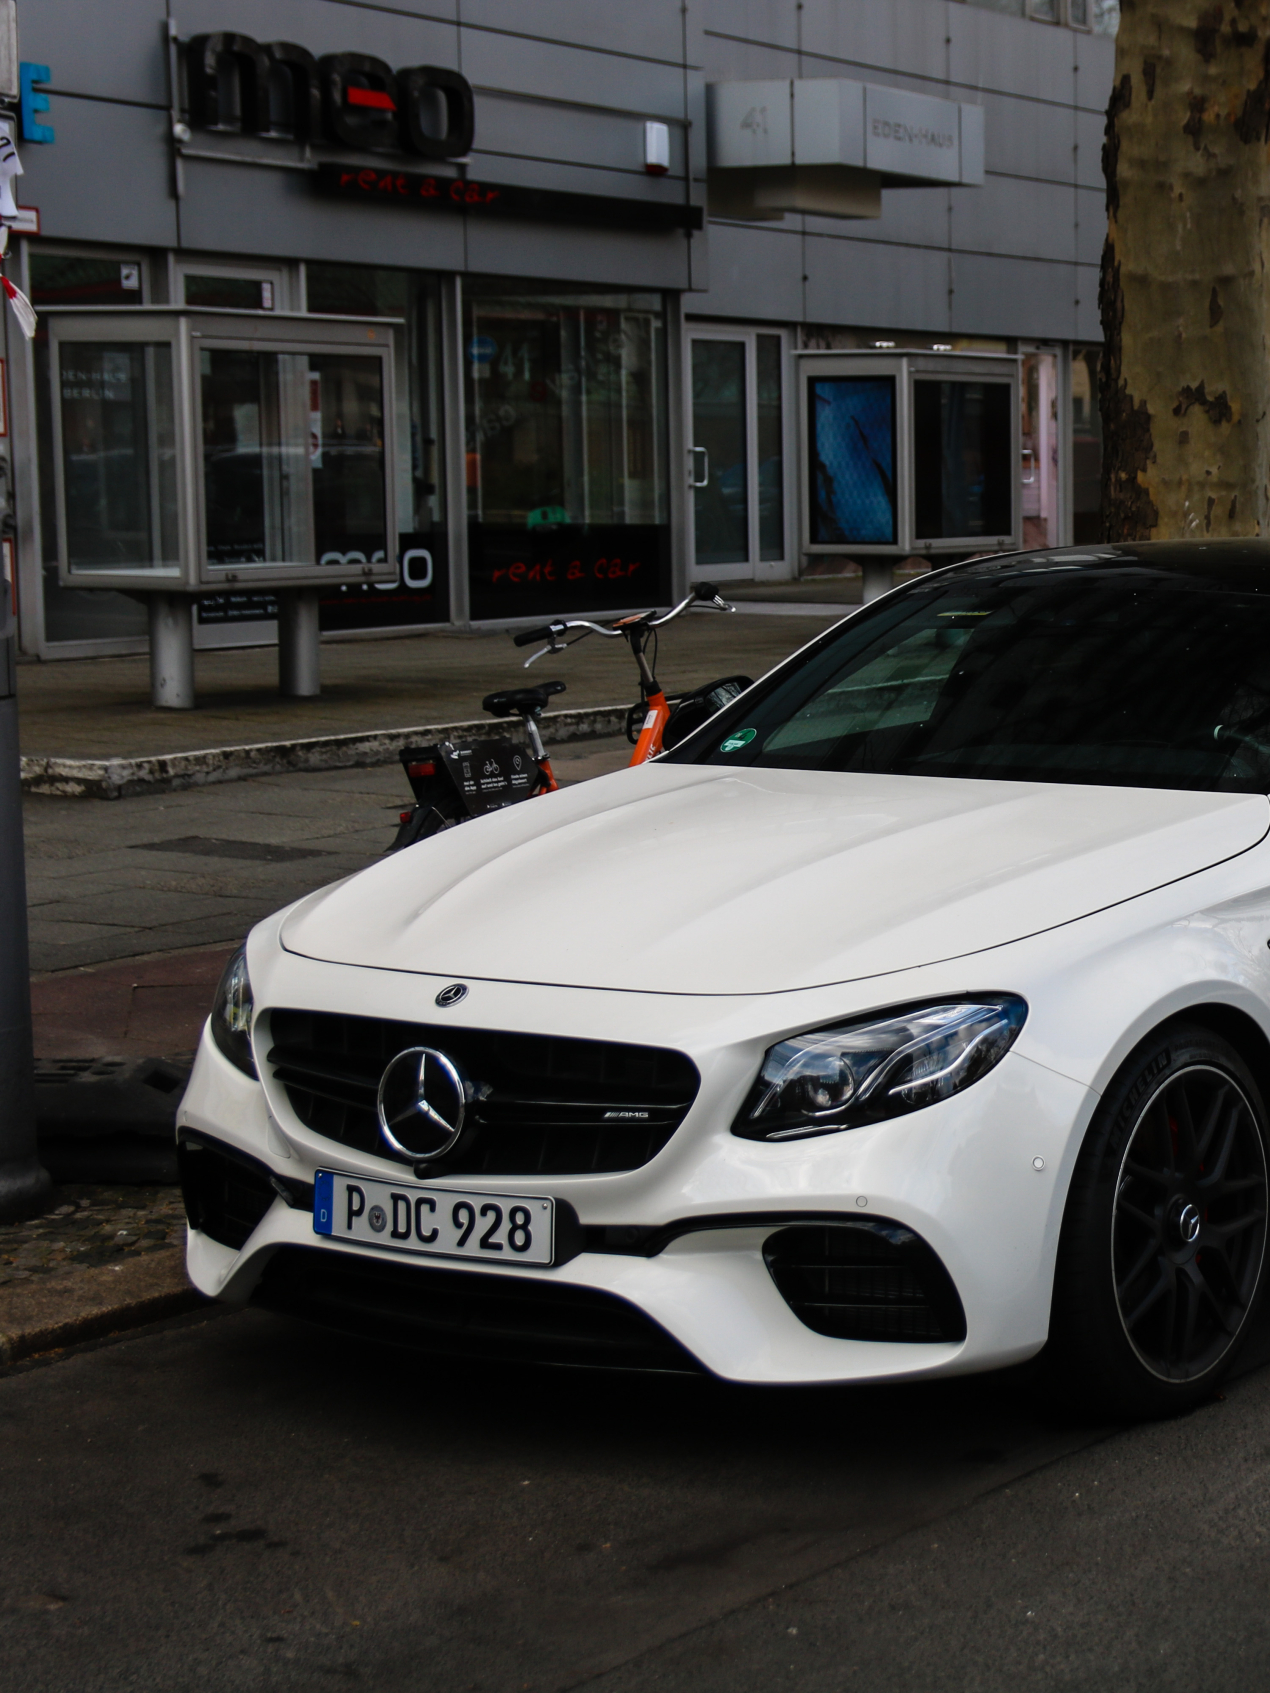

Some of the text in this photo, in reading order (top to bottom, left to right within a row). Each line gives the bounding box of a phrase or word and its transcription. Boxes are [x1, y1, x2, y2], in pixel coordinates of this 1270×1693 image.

[20, 62, 55, 143] E
[188, 31, 475, 159] meo
[740, 107, 768, 135] 41
[872, 118, 954, 148] EDEN-HAUS
[339, 168, 410, 196] rent
[448, 179, 501, 205] car
[498, 342, 531, 382] 41
[62, 387, 115, 400] BERLIN
[491, 557, 641, 584] rent a car
[1110, 1050, 1169, 1149] MICHELIN
[346, 1184, 534, 1253] P DC 928
